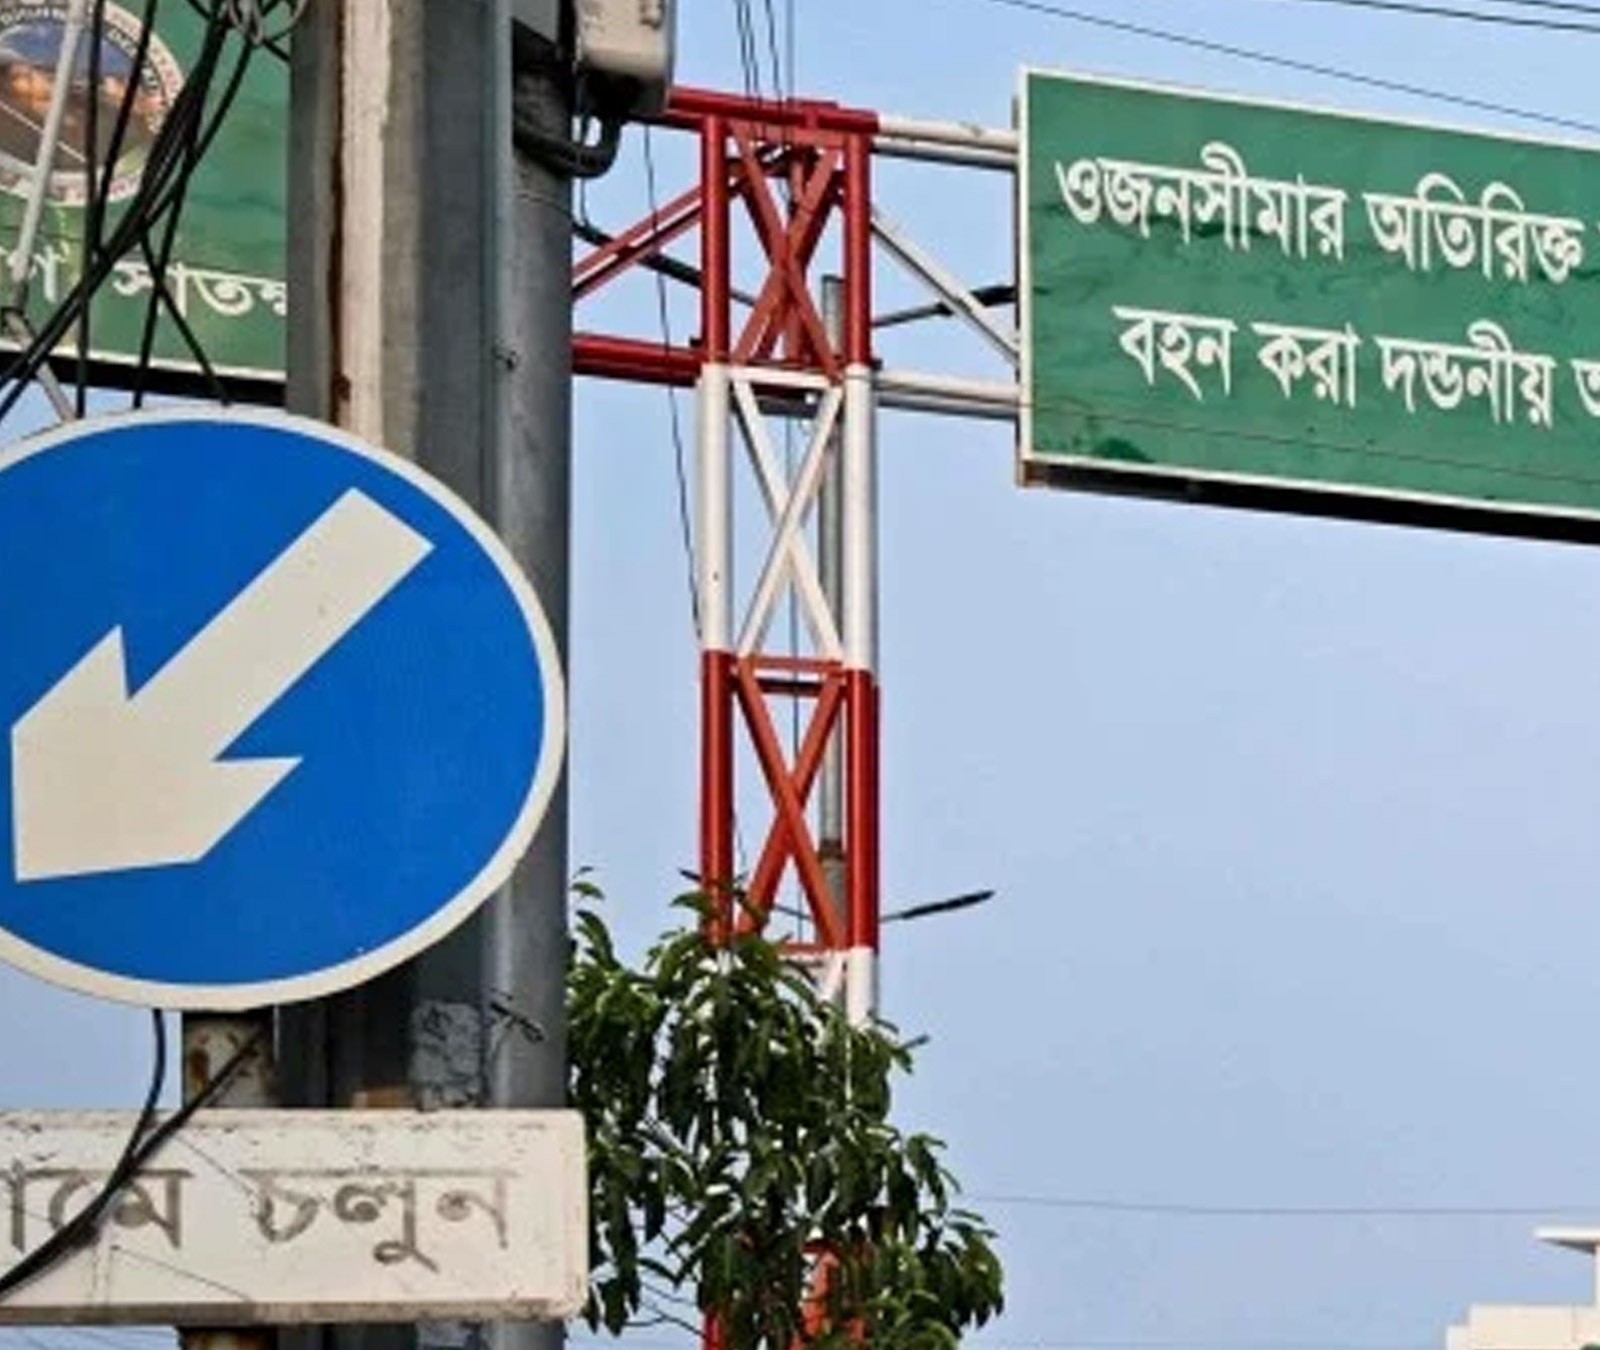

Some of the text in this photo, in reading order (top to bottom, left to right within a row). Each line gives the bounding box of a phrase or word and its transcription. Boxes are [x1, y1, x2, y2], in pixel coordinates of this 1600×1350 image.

[1056, 142, 1347, 260] ওজনসীমার
[1363, 173, 1585, 281] অতিরিক্ত
[1113, 306, 1237, 399] বহন
[1252, 322, 1362, 407] করা
[237, 1167, 524, 1275] চলুন
